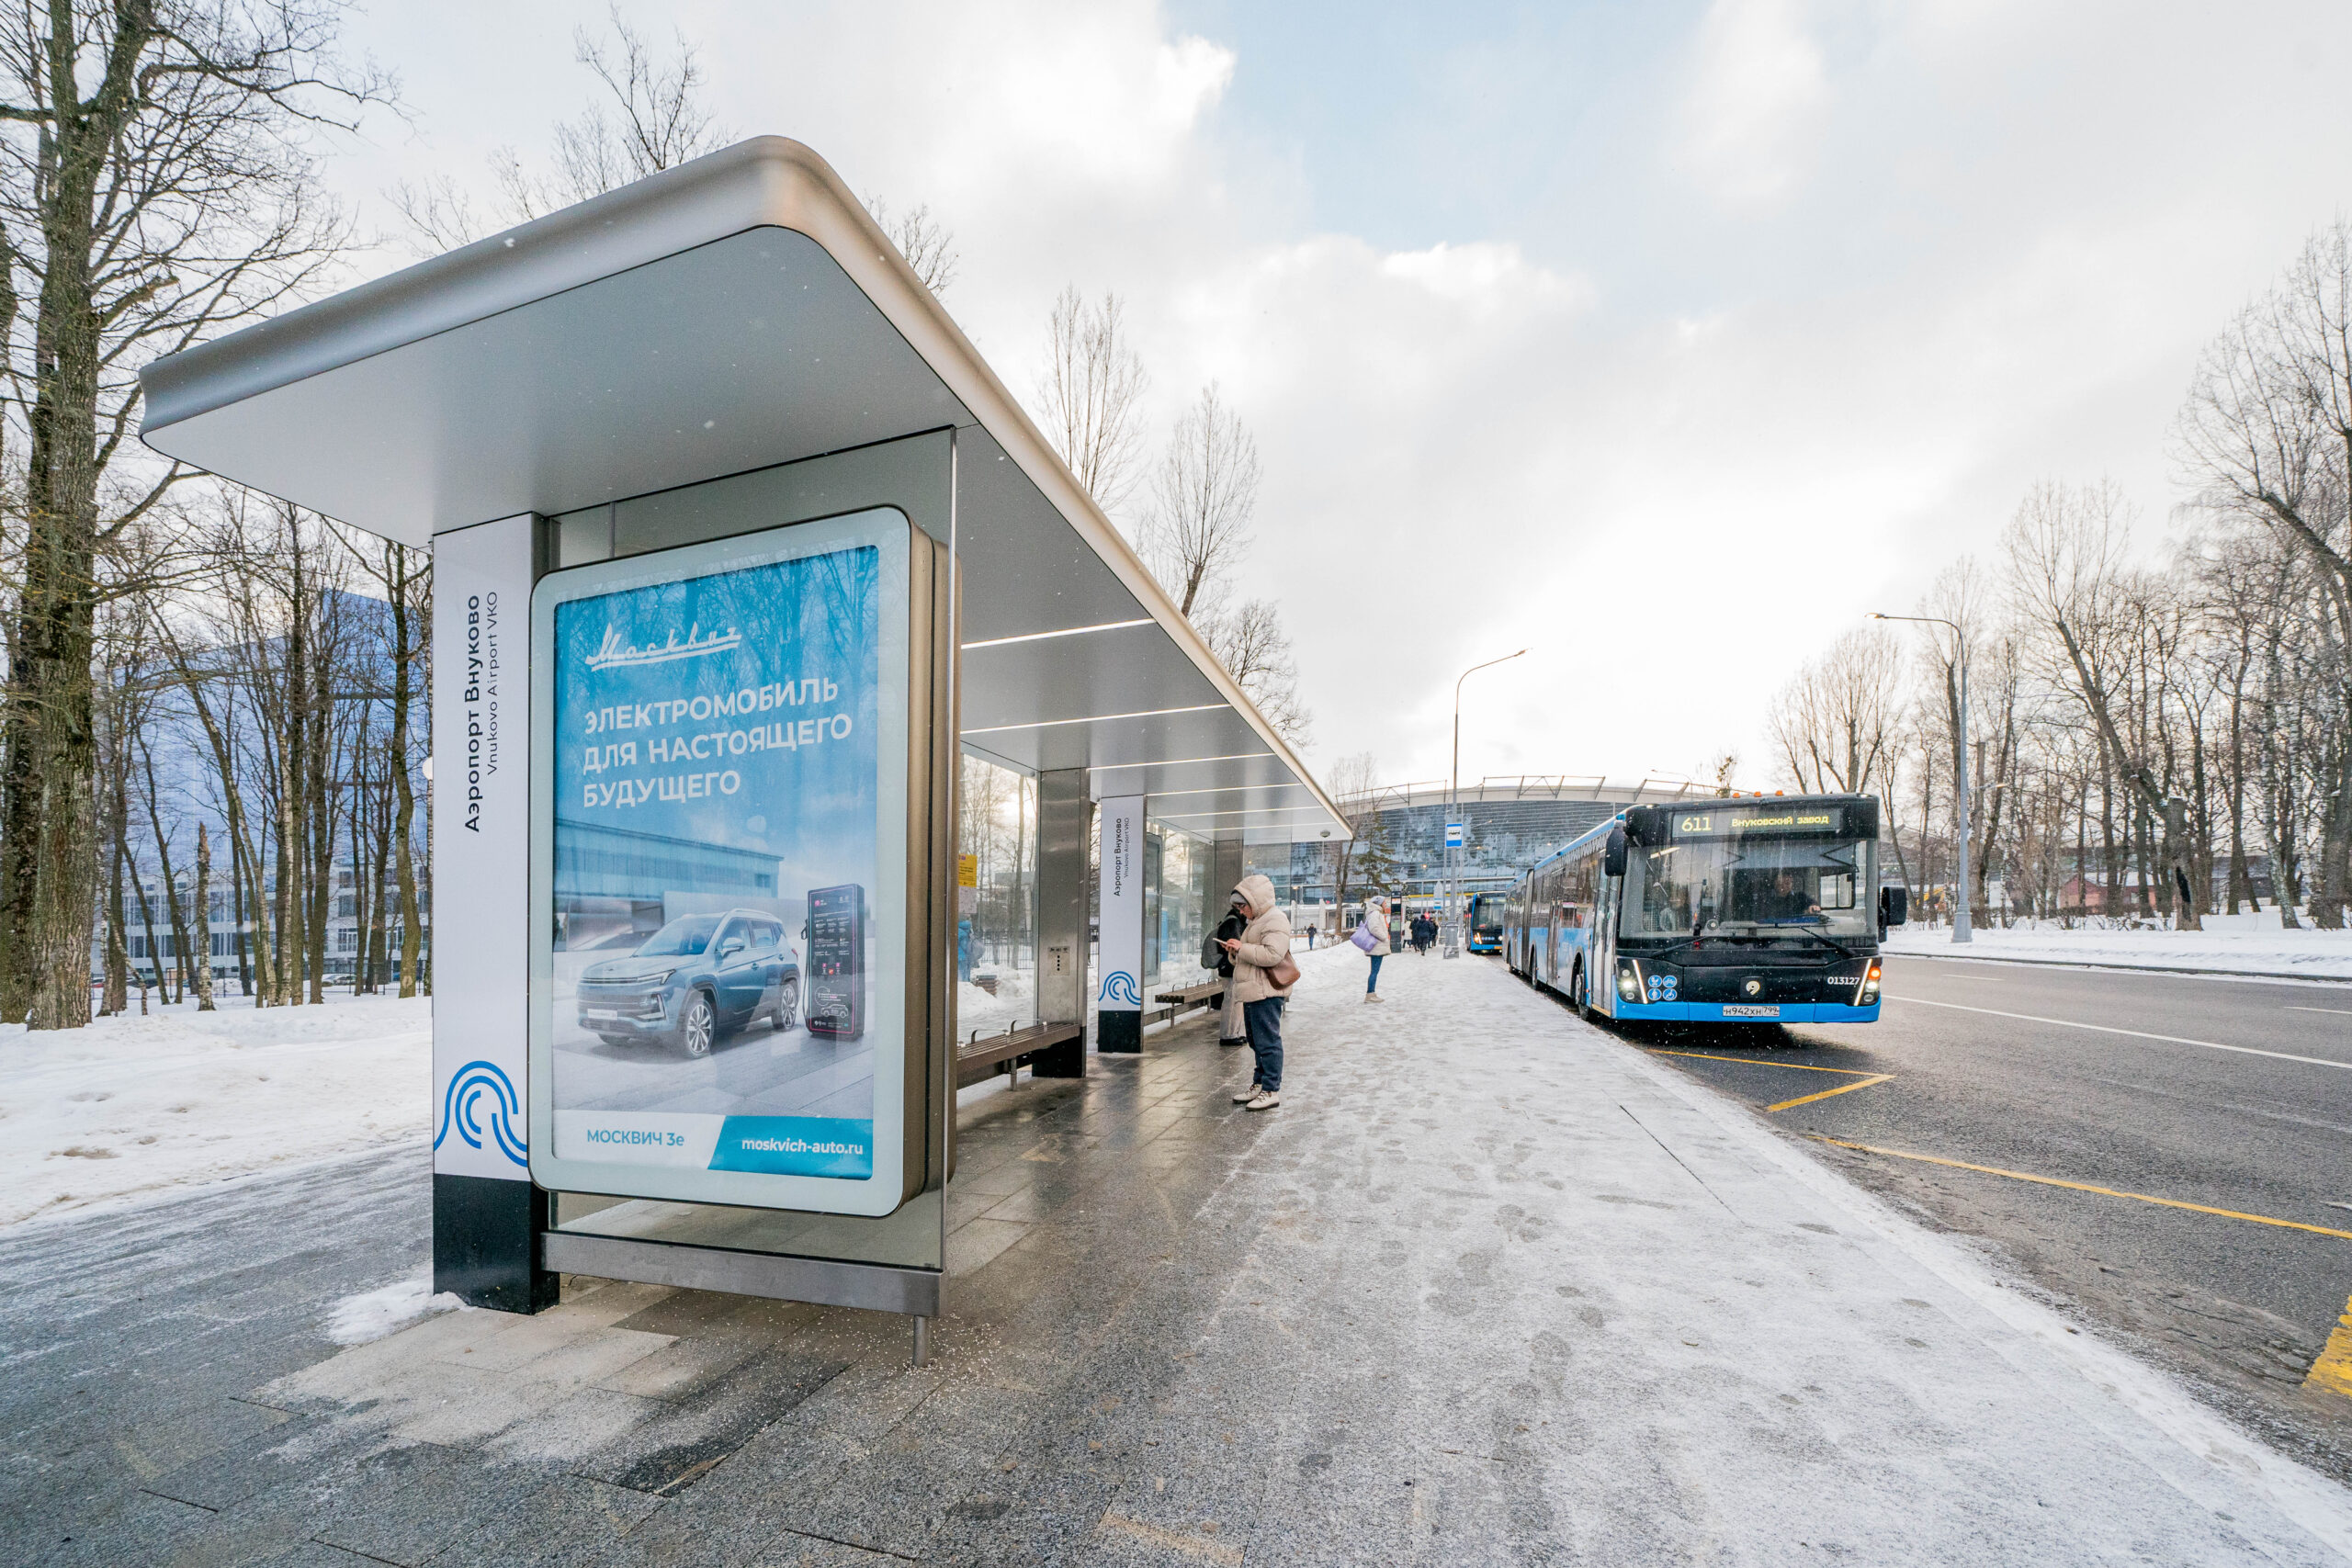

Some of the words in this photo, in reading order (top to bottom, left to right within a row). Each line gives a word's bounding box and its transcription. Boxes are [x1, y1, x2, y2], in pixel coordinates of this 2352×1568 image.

[486, 591, 499, 630] VKO
[464, 594, 483, 703] Внуково
[486, 633, 501, 696] Airport
[585, 622, 742, 671] Москвич
[584, 678, 839, 735] ЭЛЕКТРОМОБИЛЬ
[486, 701, 498, 775] Vnukovo
[582, 739, 637, 777] ДЛЯ
[650, 713, 853, 765] НАСТОЯЩЕГО
[464, 709, 483, 832] Аэропорт
[583, 769, 741, 809] БУДУЩЕГО
[1114, 818, 1123, 853] Внуково
[1681, 816, 1712, 832] 611
[1732, 816, 1792, 827] Внуковский
[1797, 815, 1829, 825] завод
[1114, 856, 1123, 897] Аэропорт
[1826, 976, 1860, 986] 013127
[586, 1128, 663, 1145] МОСКВИЧ
[666, 1131, 684, 1148] 3е
[741, 1136, 864, 1156] moskvich-auto.ru
